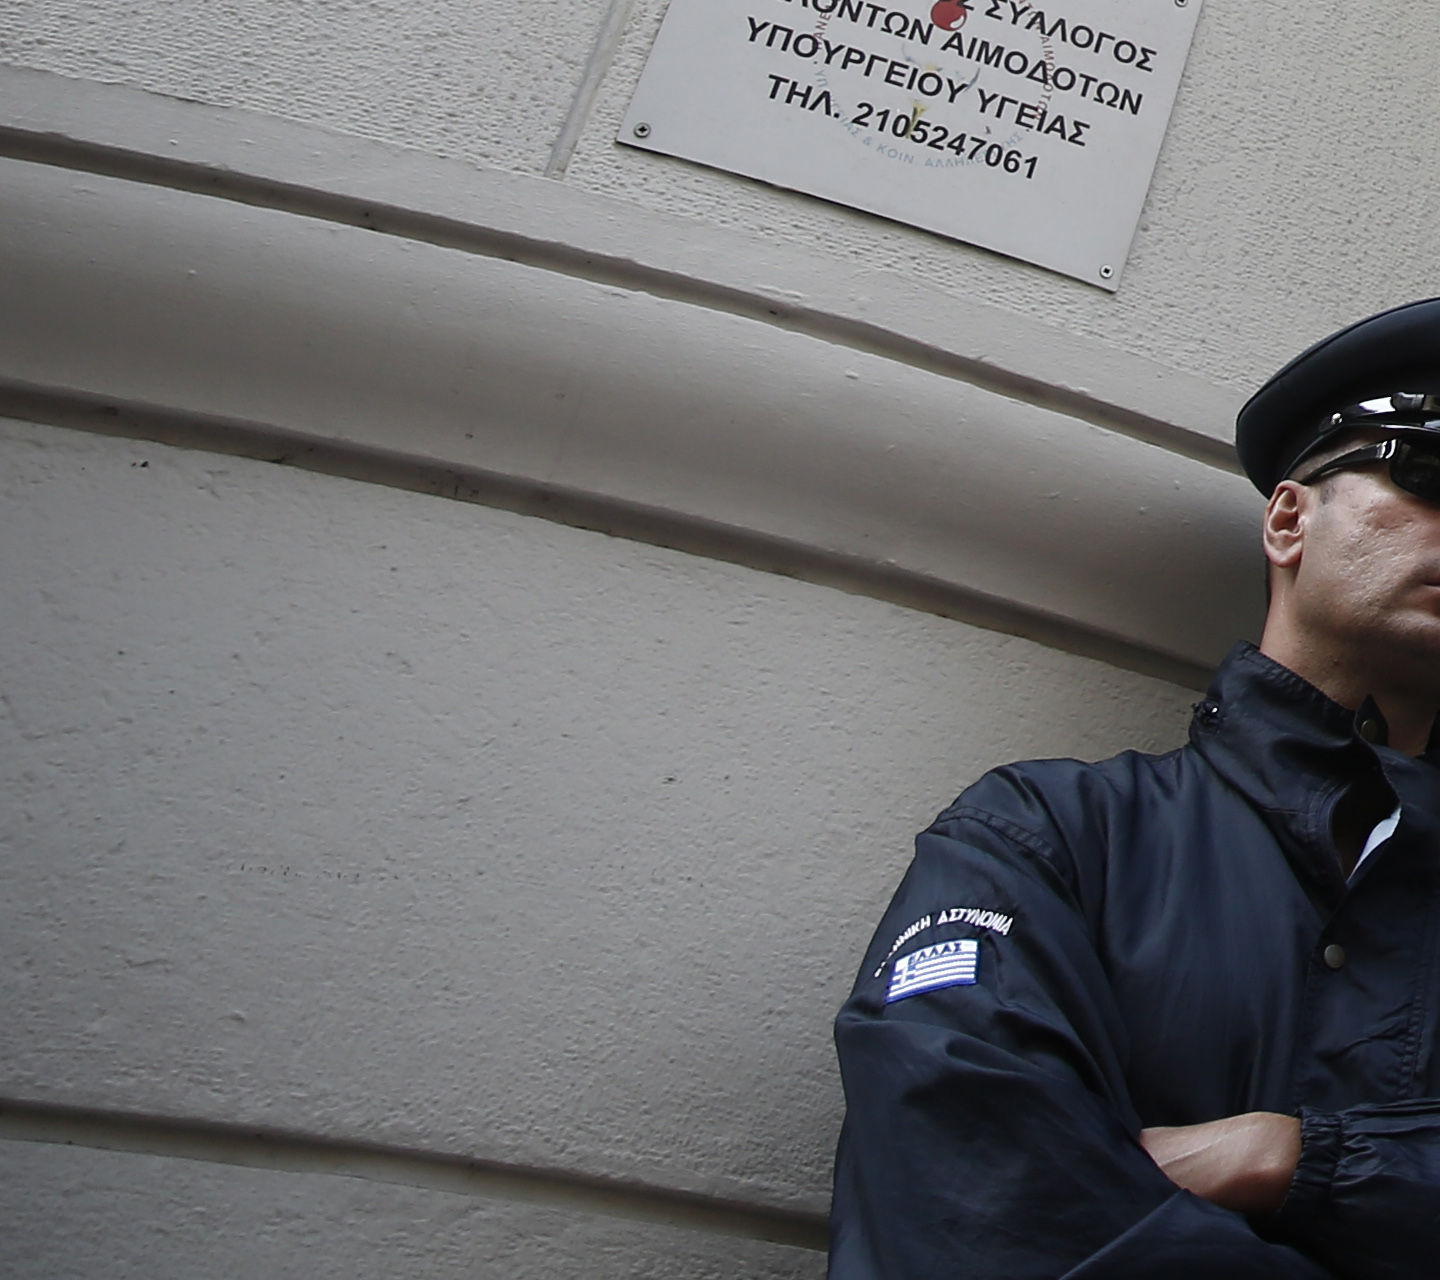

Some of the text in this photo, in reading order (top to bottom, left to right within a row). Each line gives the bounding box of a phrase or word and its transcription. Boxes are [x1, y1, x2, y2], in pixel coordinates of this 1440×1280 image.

[745, 17, 1091, 146] ΥΠΟΥΡΓΕΙΟΥ ΥΓΕΙΑΣ
[940, 32, 1143, 115] ΑΙΜΟΔΟΤΩΝ
[766, 74, 1038, 179] ΤΗΛ. 2105247061
[937, 908, 1014, 936] ΑΣΤΥΝΟΜΙΑ
